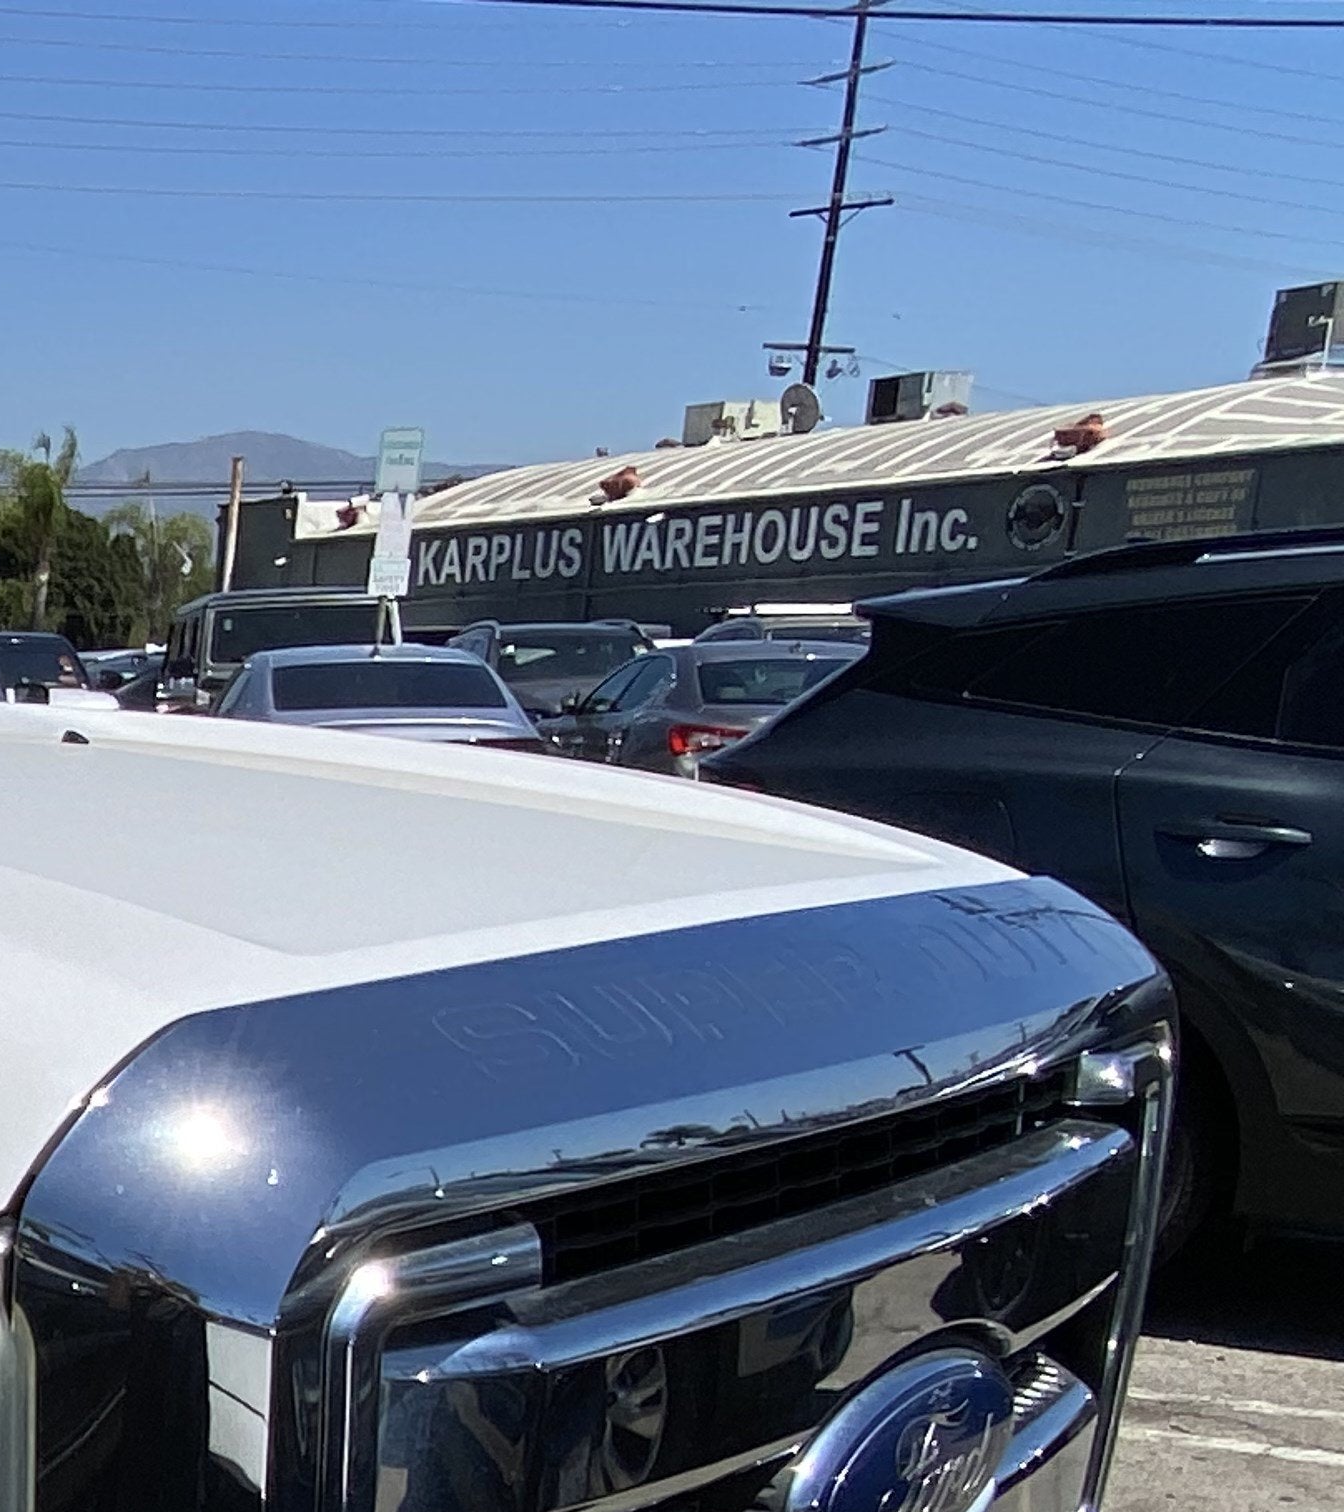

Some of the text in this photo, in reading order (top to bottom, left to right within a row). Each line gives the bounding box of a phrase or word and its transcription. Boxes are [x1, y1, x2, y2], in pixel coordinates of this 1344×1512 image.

[416, 498, 978, 586] KARPLUS WAREHOUSE Inc.
